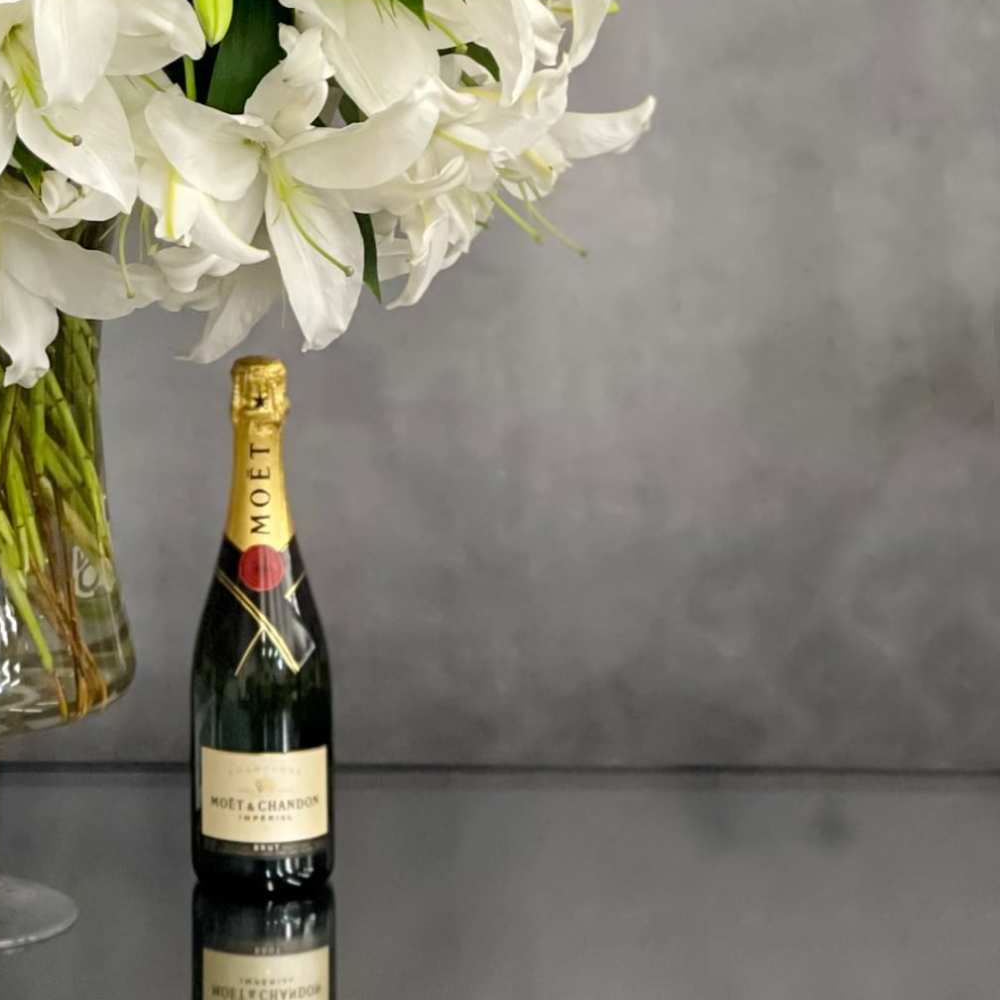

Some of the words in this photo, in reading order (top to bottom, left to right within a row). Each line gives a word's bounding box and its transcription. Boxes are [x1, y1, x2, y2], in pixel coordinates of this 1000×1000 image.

[247, 802, 256, 812] &
[258, 795, 320, 812] CHANDON
[253, 843, 280, 851] BRUT
